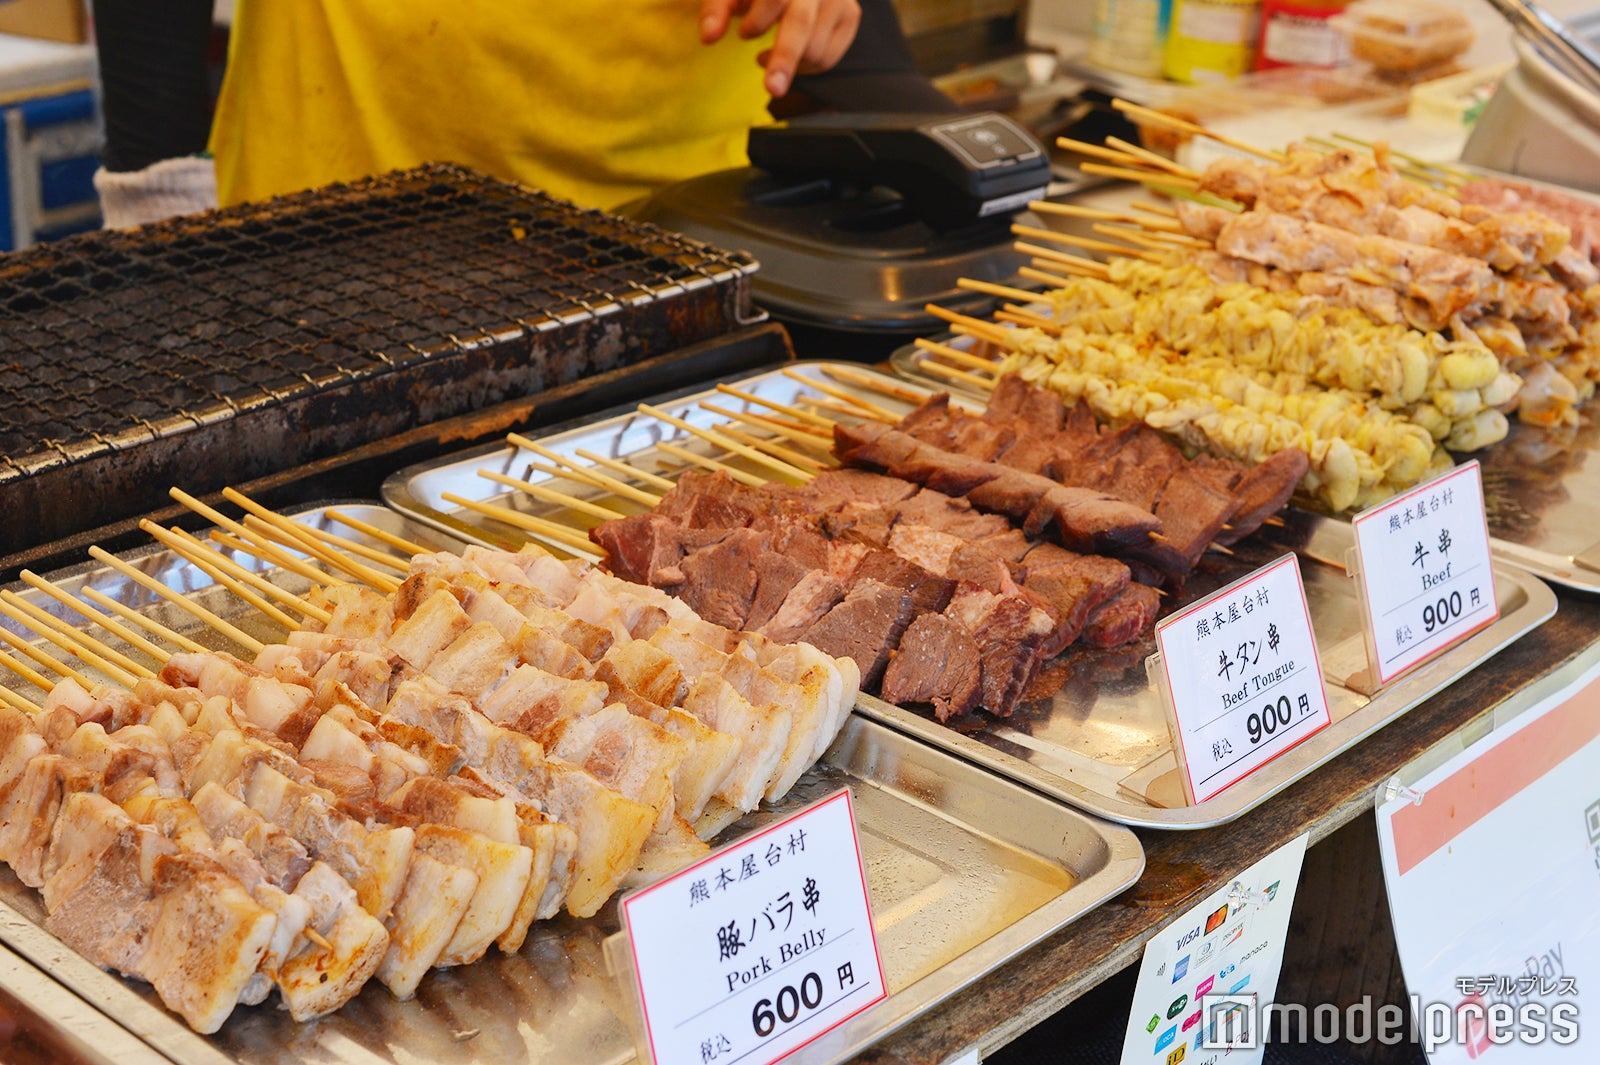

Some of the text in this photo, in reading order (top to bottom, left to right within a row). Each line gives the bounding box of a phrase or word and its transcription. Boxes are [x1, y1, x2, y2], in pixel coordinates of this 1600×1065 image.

[1389, 487, 1454, 534] 熊本屋台村
[1412, 528, 1452, 569] 牛串
[1421, 562, 1452, 591] Beef
[1196, 586, 1269, 641] 熊本屋台村
[1395, 587, 1481, 646] 税込 900 円
[1218, 622, 1280, 682] 牛タン串
[1221, 658, 1295, 710] Beef Tongue
[1212, 693, 1310, 762] 税込 900 円
[689, 829, 808, 908] 熊本屋台村
[717, 877, 821, 962] 豚バラ串
[1177, 926, 1200, 951] VISA
[725, 928, 827, 993] Pork Belly
[699, 961, 855, 1064] 税込 600 円
